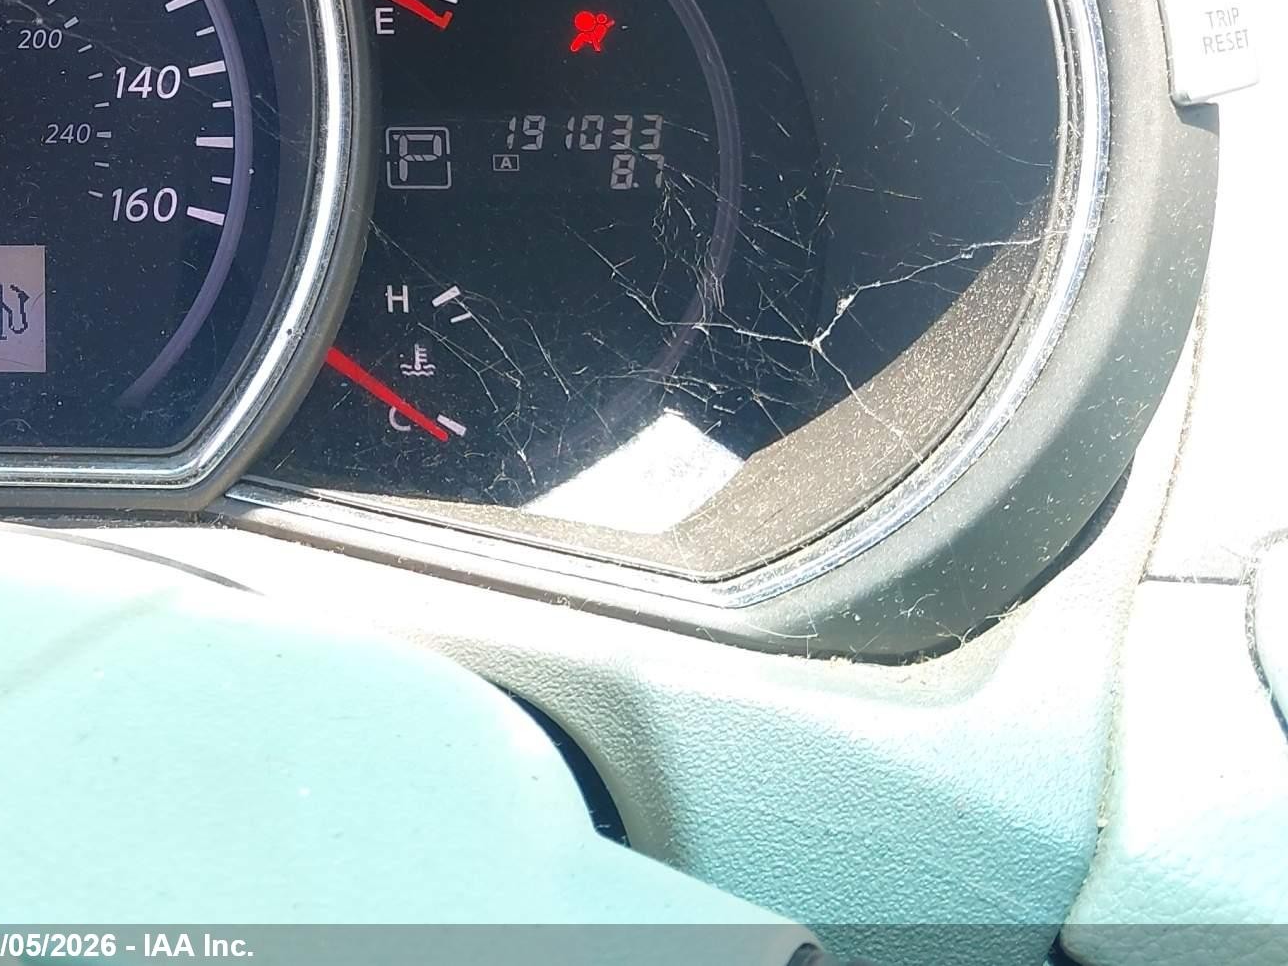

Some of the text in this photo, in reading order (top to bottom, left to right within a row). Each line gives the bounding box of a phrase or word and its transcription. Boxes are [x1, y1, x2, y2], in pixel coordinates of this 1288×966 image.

[376, 8, 394, 34] E
[1205, 7, 1239, 29] TRIP
[18, 29, 62, 48] 200
[1203, 29, 1249, 55] RESET
[117, 66, 180, 98] 140
[46, 124, 90, 143] 240
[507, 115, 662, 151] 191033
[393, 134, 443, 182] P
[500, 157, 512, 169] A
[610, 154, 664, 190] 8.7
[113, 188, 177, 221] 160
[385, 285, 408, 312] H
